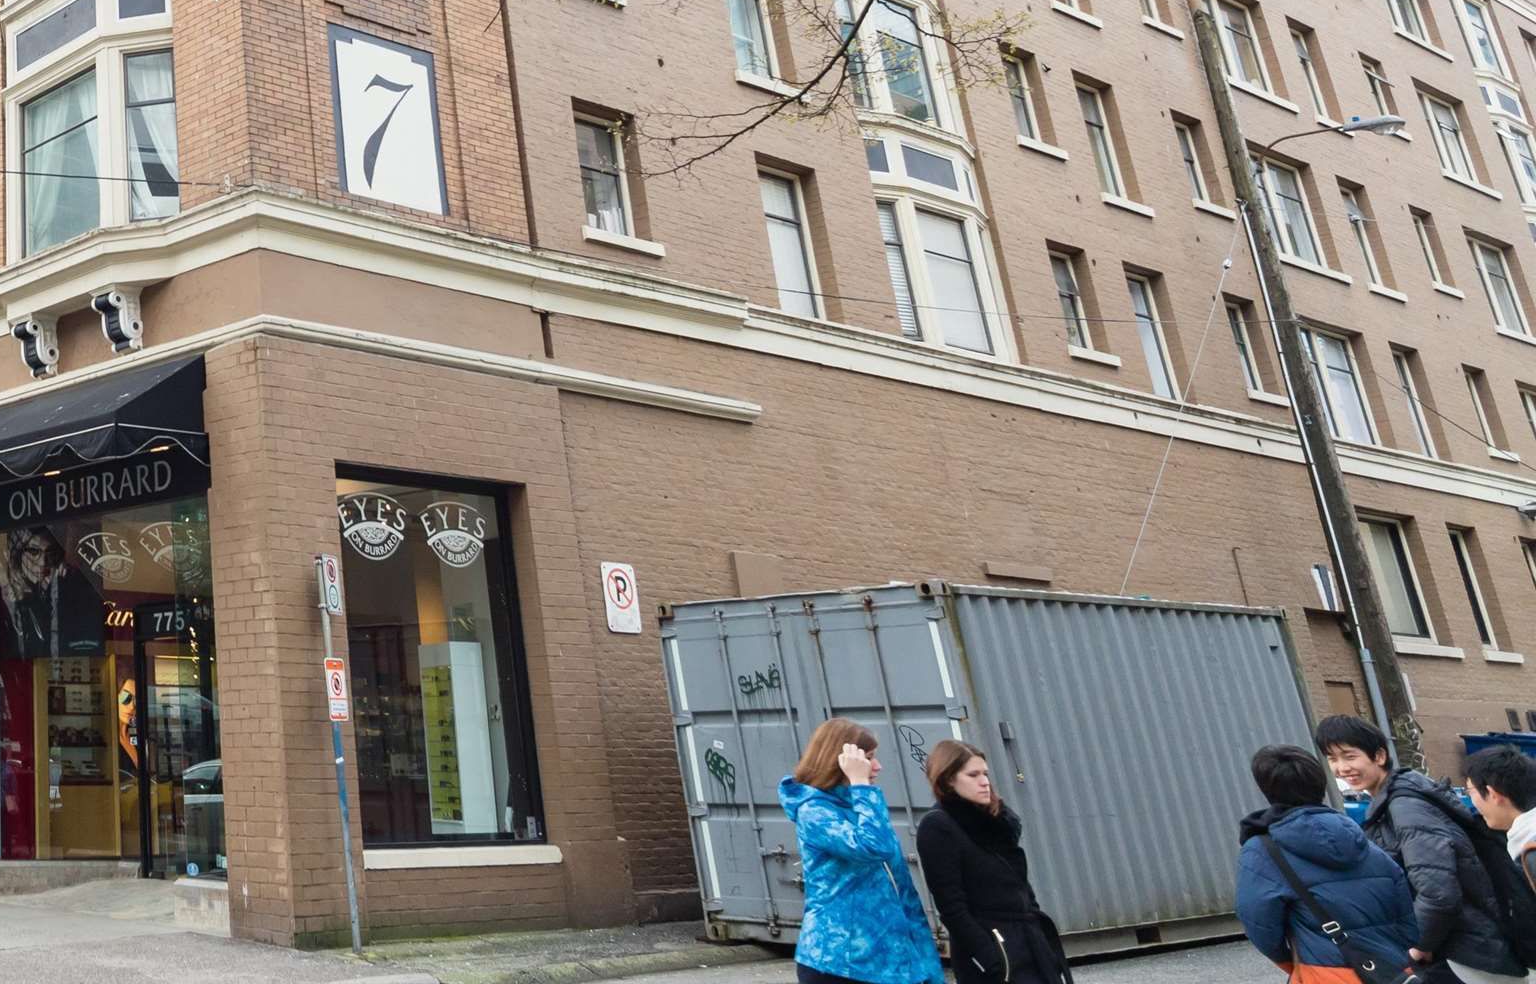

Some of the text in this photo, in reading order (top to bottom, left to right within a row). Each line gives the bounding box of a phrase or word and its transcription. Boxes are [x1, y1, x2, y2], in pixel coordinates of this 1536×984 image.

[363, 74, 414, 190] 7
[9, 485, 43, 520] ON
[56, 460, 172, 512] BURRARD
[337, 497, 407, 532] EYES
[419, 506, 486, 540] EYES
[77, 536, 132, 566] EYES
[351, 532, 398, 557] ON BURRARD
[434, 540, 479, 564] ON BURRARD
[153, 610, 185, 632] 775
